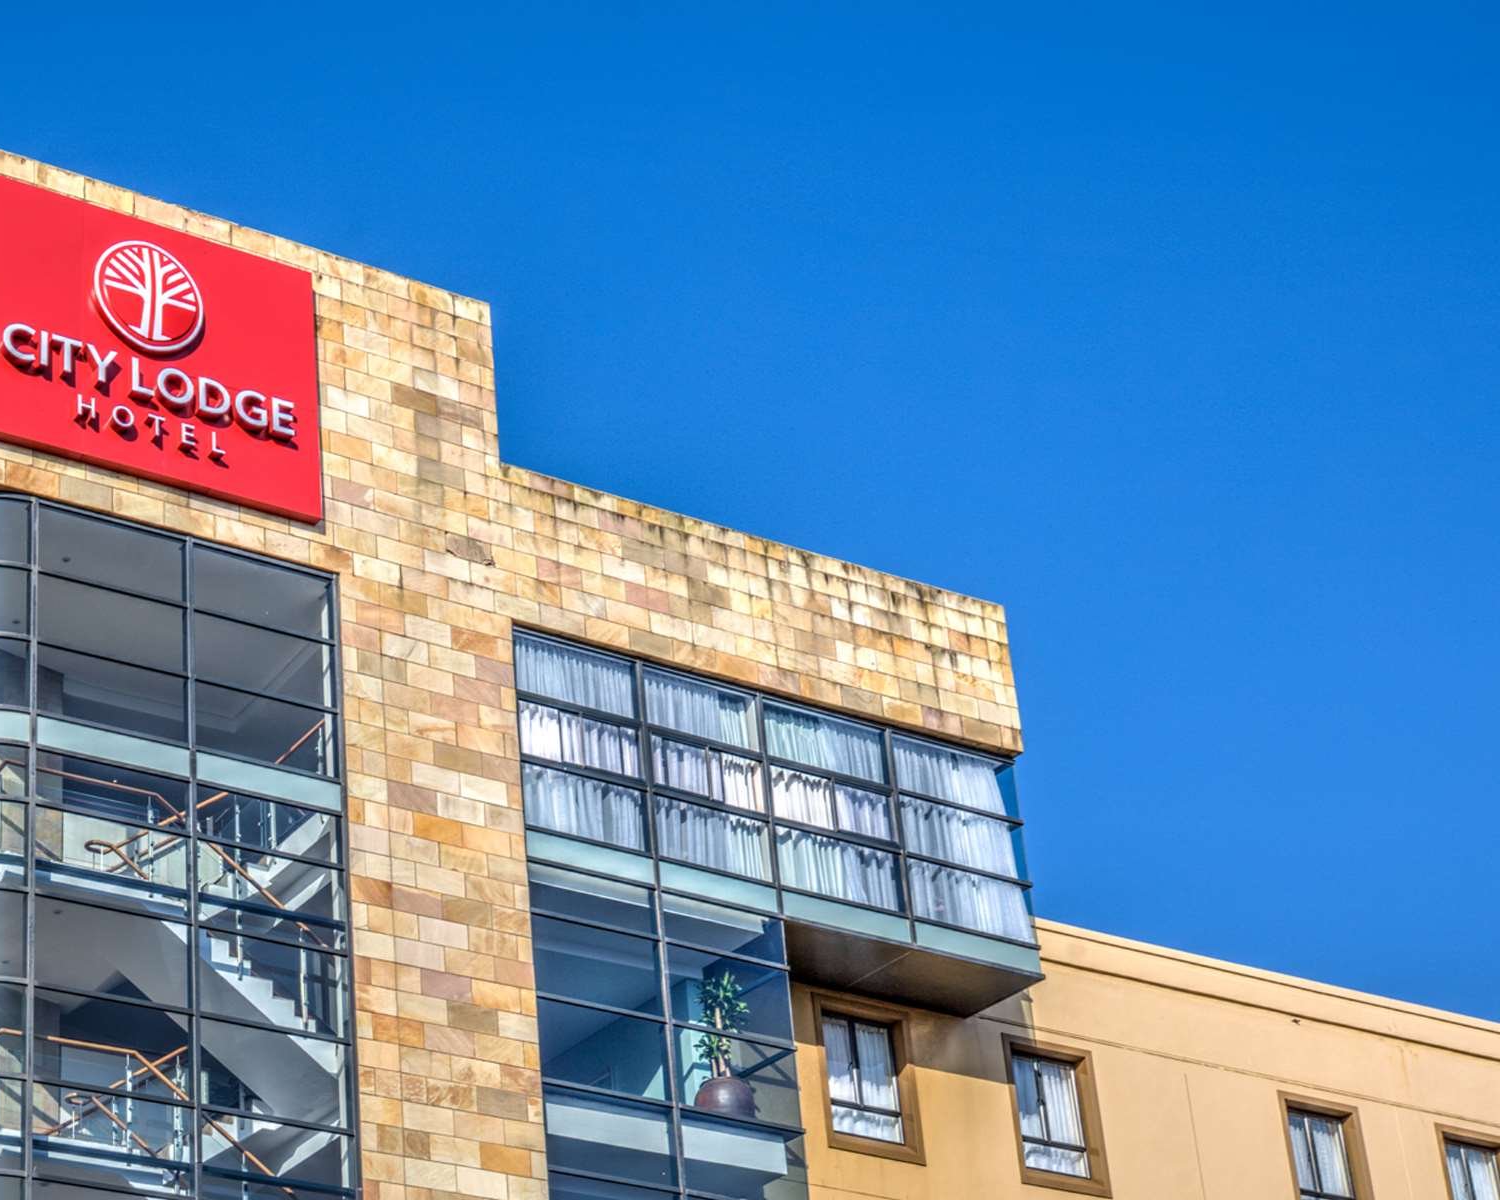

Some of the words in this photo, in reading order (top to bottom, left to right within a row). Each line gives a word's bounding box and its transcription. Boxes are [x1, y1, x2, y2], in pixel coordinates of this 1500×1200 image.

[2, 323, 118, 383] CITY
[131, 356, 296, 438] LODGE
[76, 393, 226, 455] HOTEL
